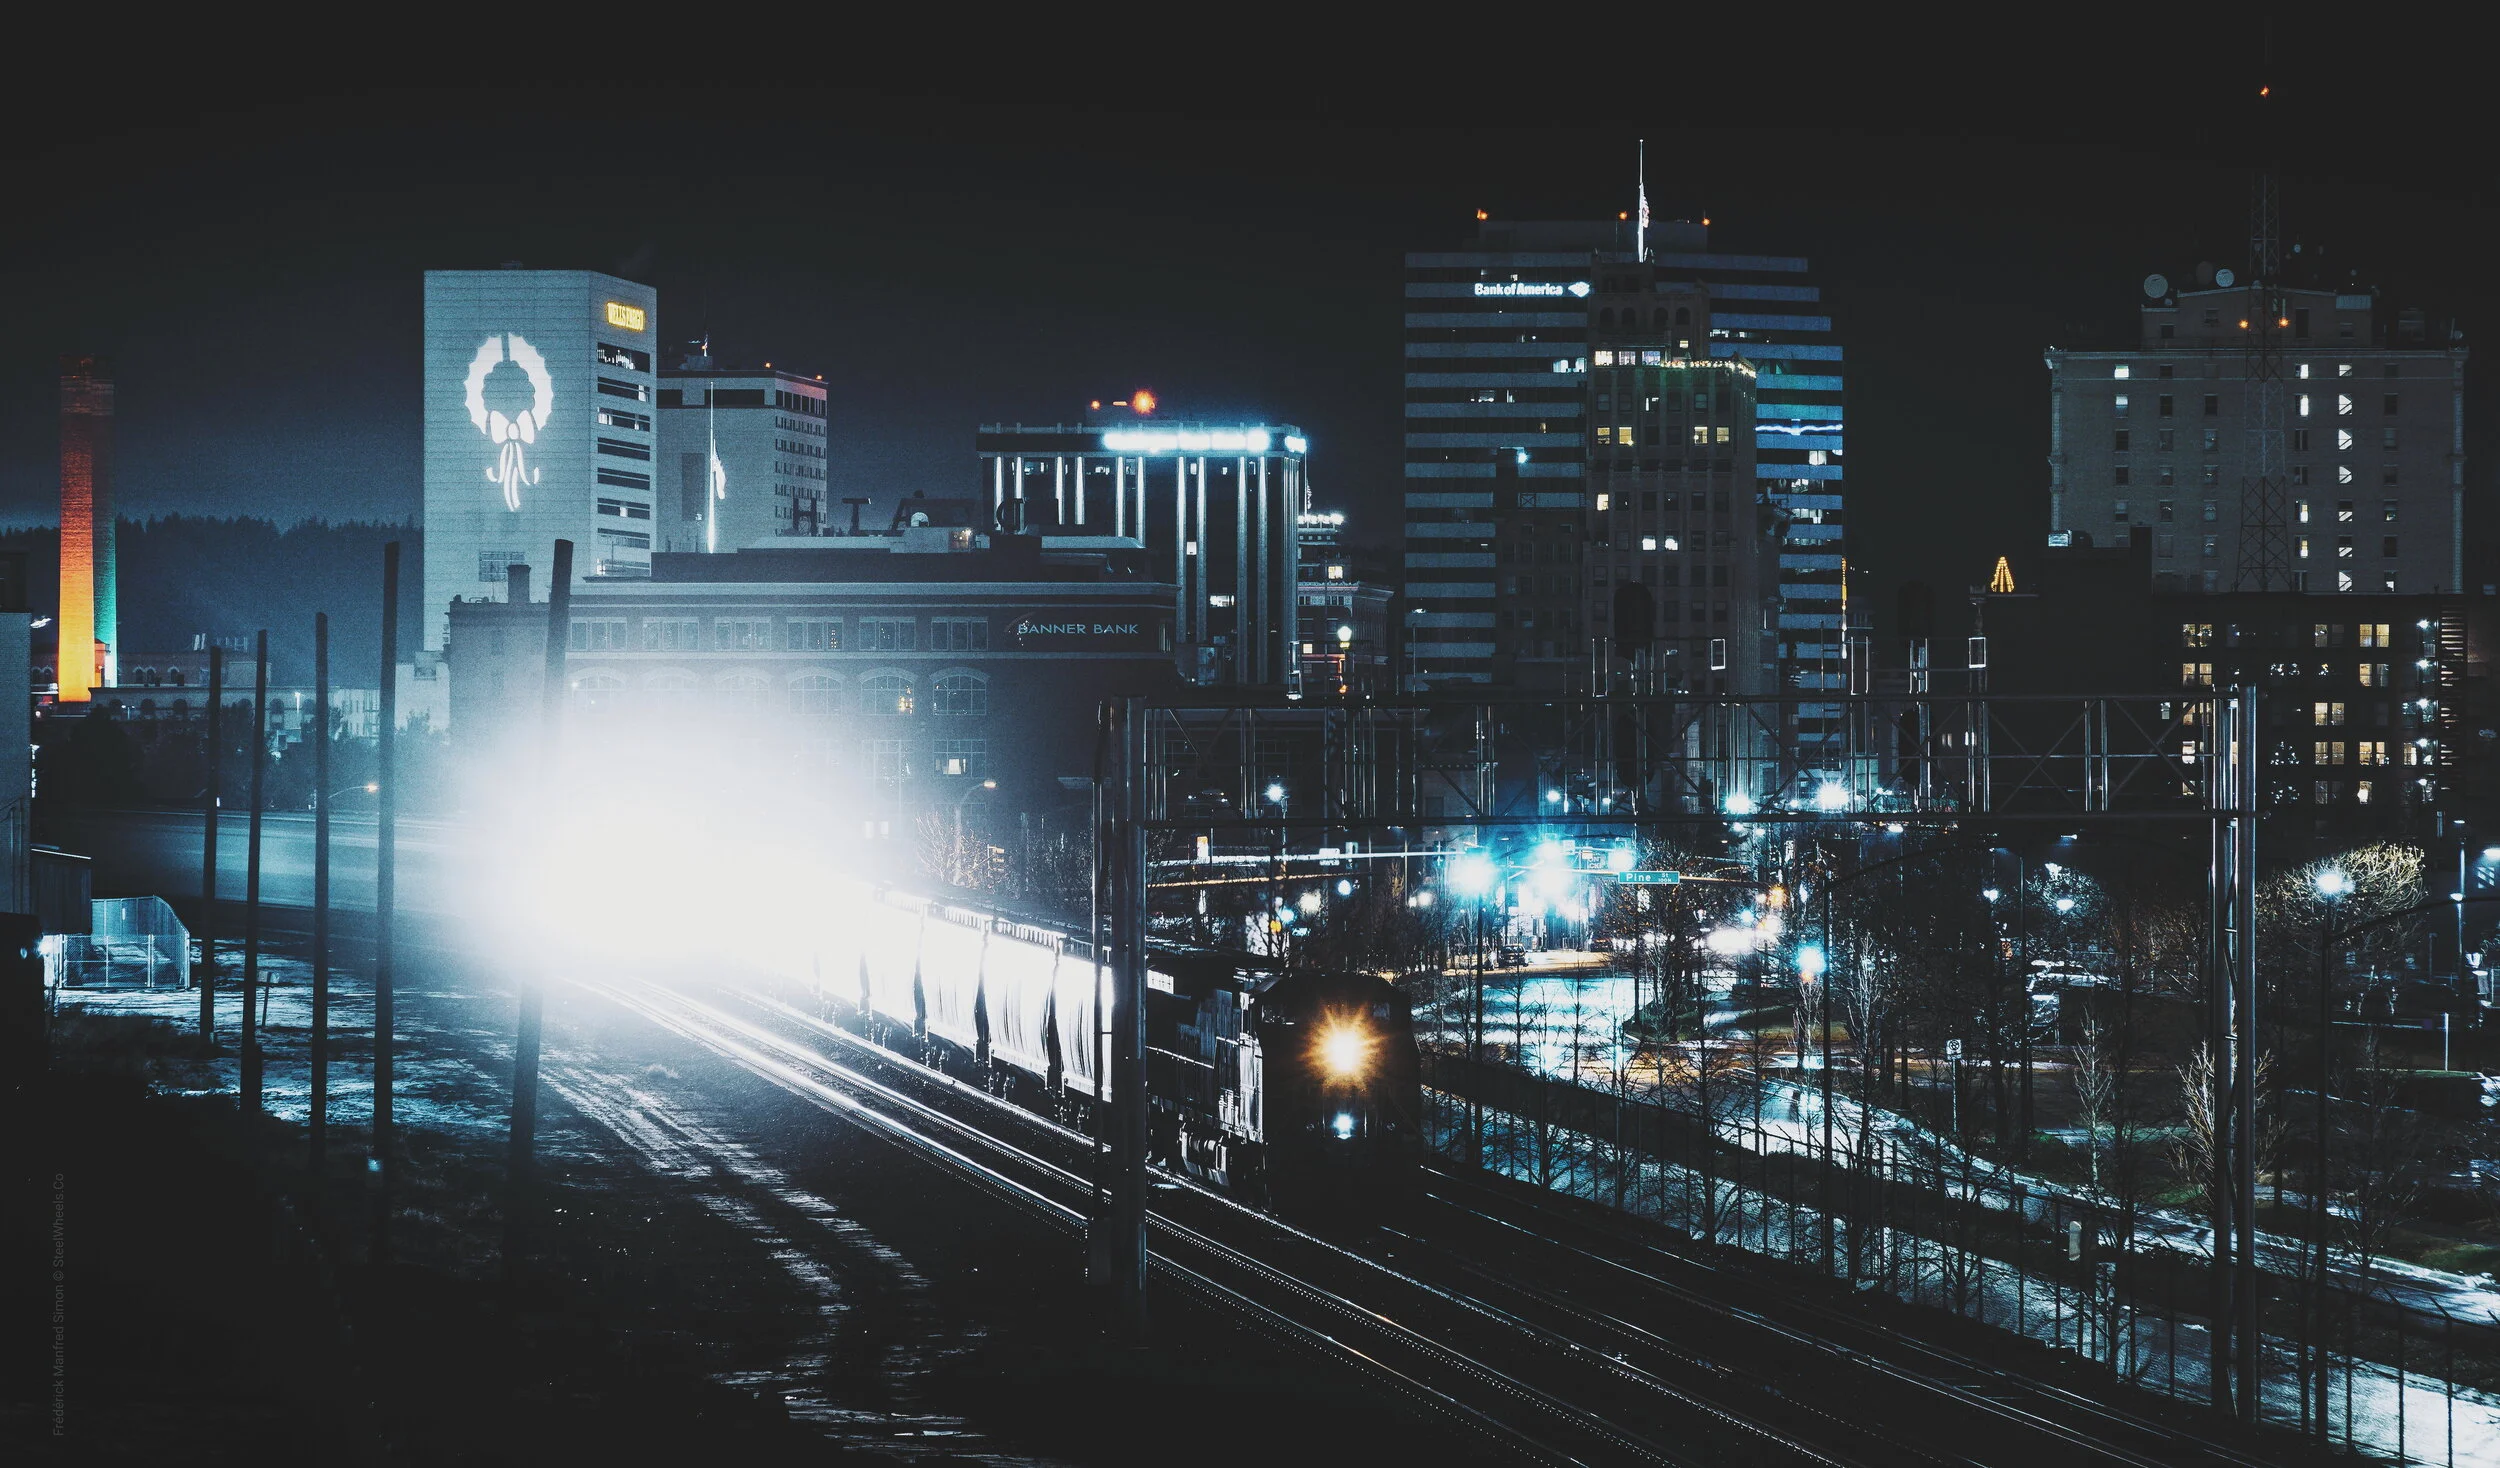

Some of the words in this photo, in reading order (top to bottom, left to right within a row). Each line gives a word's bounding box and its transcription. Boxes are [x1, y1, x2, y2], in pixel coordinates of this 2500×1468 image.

[1474, 283, 1503, 296] Bank
[1503, 283, 1517, 296] of
[1516, 283, 1564, 296] America
[1018, 623, 1087, 635] BANNER
[1093, 623, 1138, 635] BANK
[1625, 873, 1652, 882] Pine
